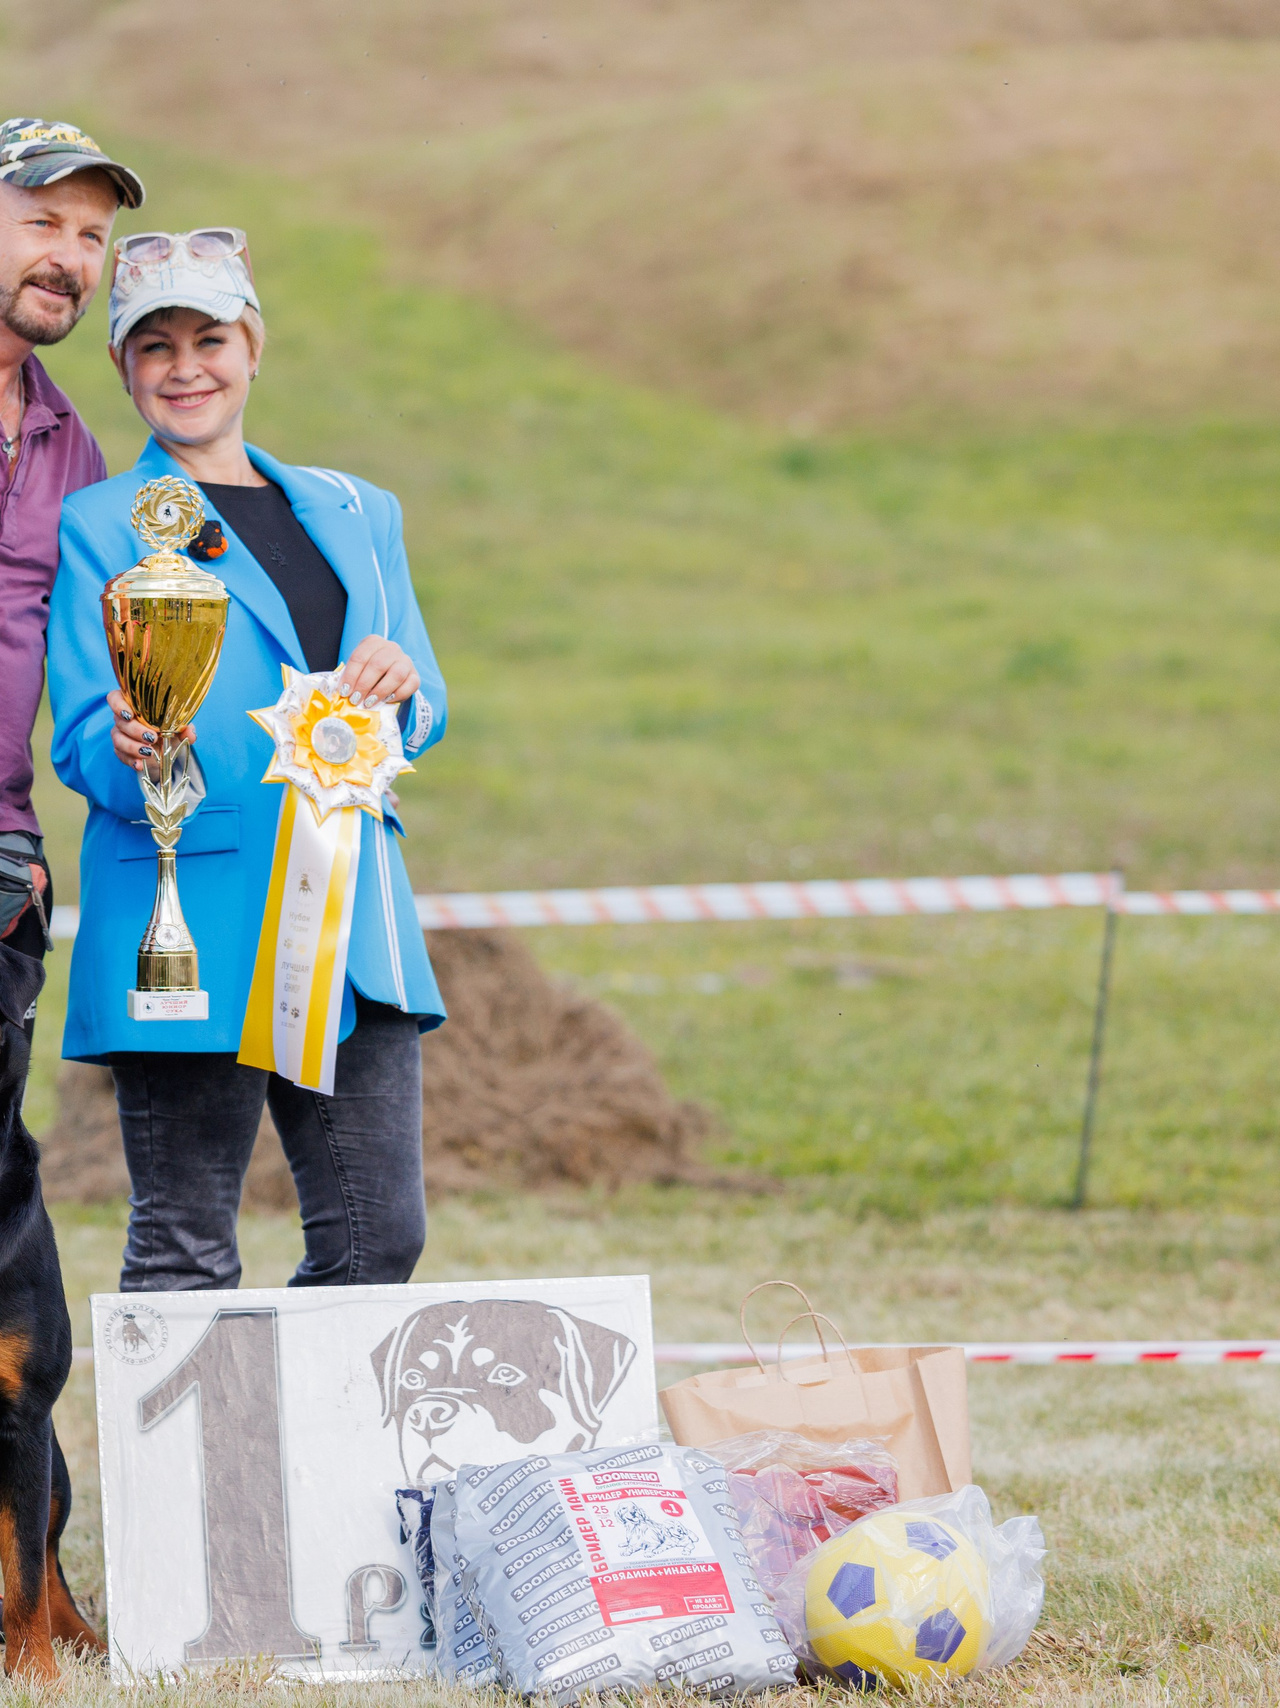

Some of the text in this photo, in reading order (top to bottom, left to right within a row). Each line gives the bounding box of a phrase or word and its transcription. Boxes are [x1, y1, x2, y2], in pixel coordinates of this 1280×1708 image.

[281, 961, 310, 974] ЛУЧШАЯ
[139, 1307, 322, 1664] 1
[481, 1458, 548, 1512] ЗООМЕНЮ
[558, 1478, 585, 1512] ЛАЙН
[587, 1488, 679, 1502] БРИДЕР УНИВЕРСАЛ
[594, 1472, 658, 1485] ЗООМЕНЮ
[492, 1481, 554, 1535] ЗООМЕНЮ
[497, 1503, 564, 1553] ЗООМЕНЮ
[592, 1506, 609, 1514] 25
[600, 1519, 615, 1528] 12
[505, 1527, 574, 1576] ЗООМЕНЮ
[576, 1517, 608, 1574] БРИДЕР
[513, 1551, 583, 1600] ЗООМЕНЮ
[598, 1564, 716, 1584] ГОВЯДИНА+ИНДЕЙКА
[521, 1577, 592, 1622] ЗООМЕНЮ
[529, 1601, 600, 1646] ЗООМЕНЮ
[652, 1615, 725, 1650] ЗООМЕНЮ
[537, 1628, 612, 1668] ЗООМЕНЮ
[658, 1645, 731, 1680] ЗООМЕНЮ
